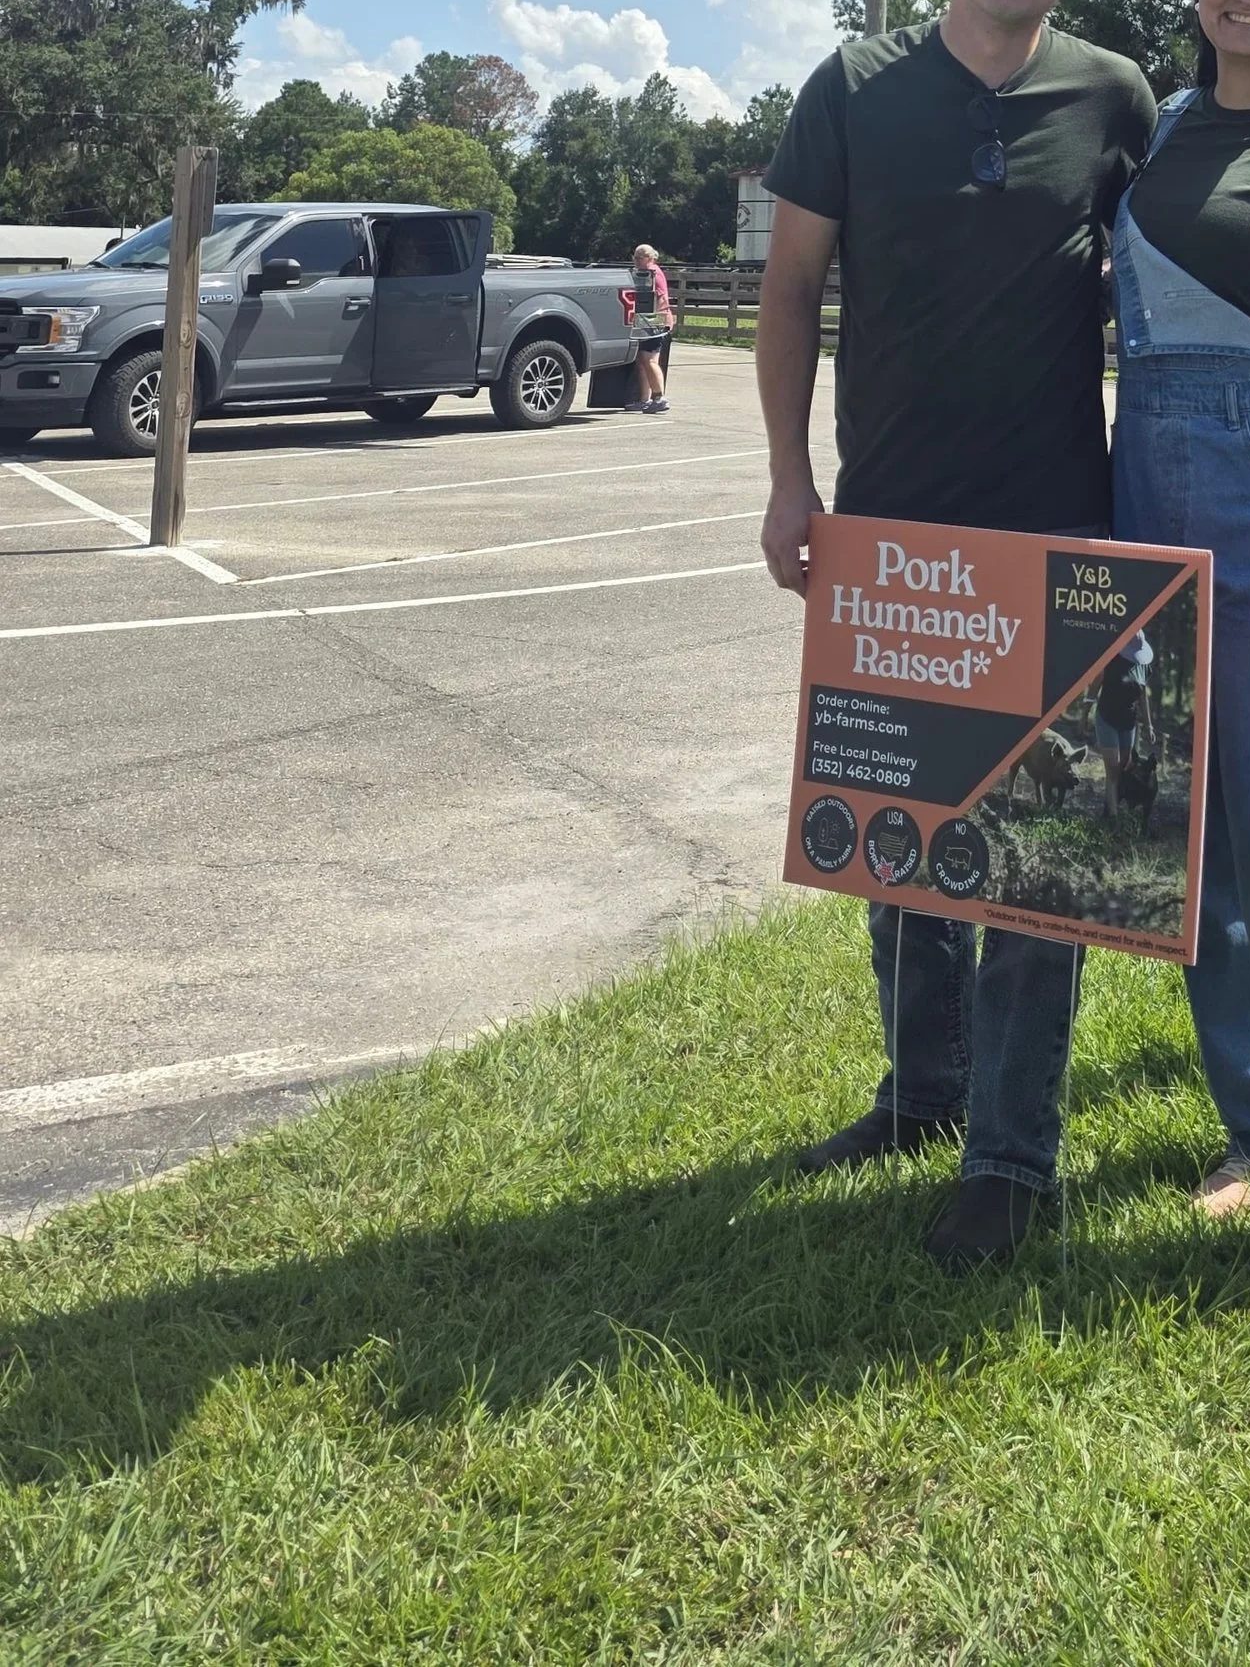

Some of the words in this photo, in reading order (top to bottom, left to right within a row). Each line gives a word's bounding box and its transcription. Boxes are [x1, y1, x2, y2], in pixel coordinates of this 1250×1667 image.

[875, 541, 976, 597] Pork
[1071, 563, 1112, 588] Y&B
[1055, 587, 1127, 617] FARMS
[830, 584, 1022, 657] Humanely
[816, 693, 848, 708] Order
[850, 698, 890, 715] Online:
[814, 710, 908, 737] yb-farms.com
[813, 740, 837, 755] Free
[839, 744, 869, 760] Local
[871, 750, 918, 771] Delivery
[811, 757, 842, 779] (352)
[846, 764, 911, 787] 462-0809
[806, 799, 826, 822] RAISED
[827, 798, 855, 830] OUTDOORS
[886, 810, 904, 826] USA
[955, 822, 967, 836] NO
[894, 848, 917, 879] RAISED
[935, 862, 980, 891] CROWDING
